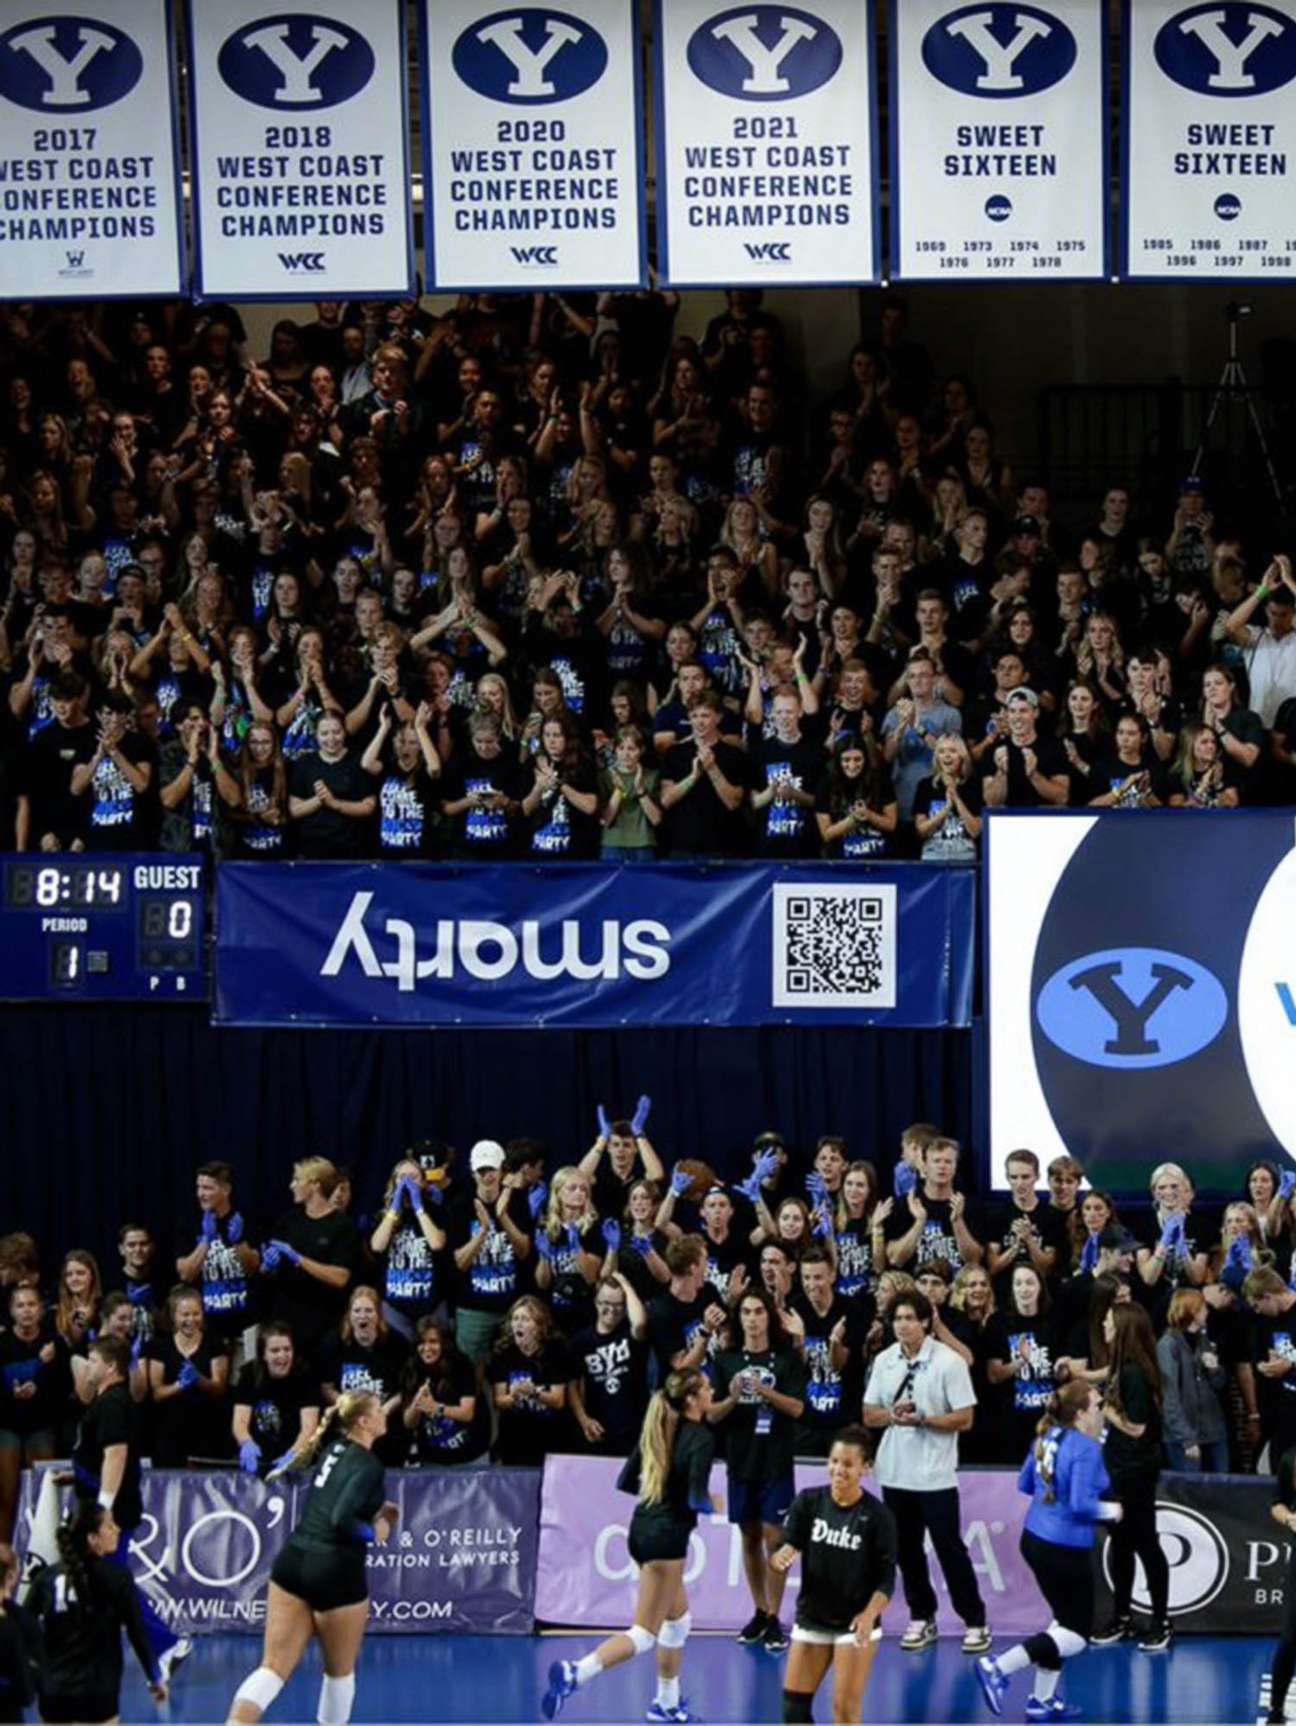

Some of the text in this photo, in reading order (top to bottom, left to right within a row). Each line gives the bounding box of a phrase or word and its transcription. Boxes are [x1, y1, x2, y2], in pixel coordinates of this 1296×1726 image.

[266, 126, 330, 148] 2018
[498, 121, 564, 142] 2020
[734, 117, 797, 138] 2021
[958, 126, 1044, 147] SWEET
[1188, 124, 1274, 146] SWEET
[34, 129, 96, 151] 2017
[217, 155, 383, 178] WEST COAST
[451, 149, 616, 172] WEST COAST
[685, 146, 850, 168] WEST COAST
[945, 155, 1055, 176] SIXTEEN
[1175, 153, 1285, 175] SIXTEEN
[69, 157, 153, 180] COAST
[217, 184, 386, 207] CONFERENCE
[451, 179, 618, 201] CONFERENCE
[685, 175, 852, 197] CONFERENCE
[4, 186, 156, 210] ONFERENCE
[222, 214, 383, 236] CHAMPIONS
[455, 208, 615, 230] CHAMPIONS
[689, 204, 849, 226] CHAMPIONS
[278, 253, 325, 270] WCC
[511, 247, 557, 264] WCC
[744, 243, 790, 260] WCC
[36, 868, 121, 906] 8:14
[134, 866, 201, 889] GUEST
[42, 917, 88, 932] PERIOD
[168, 901, 192, 938] 0
[68, 946, 79, 979] 1
[400, 1530, 414, 1548] &
[424, 1526, 522, 1548] O'REILLY
[811, 1517, 862, 1551] Duke
[439, 1550, 520, 1567] LAWYERS
